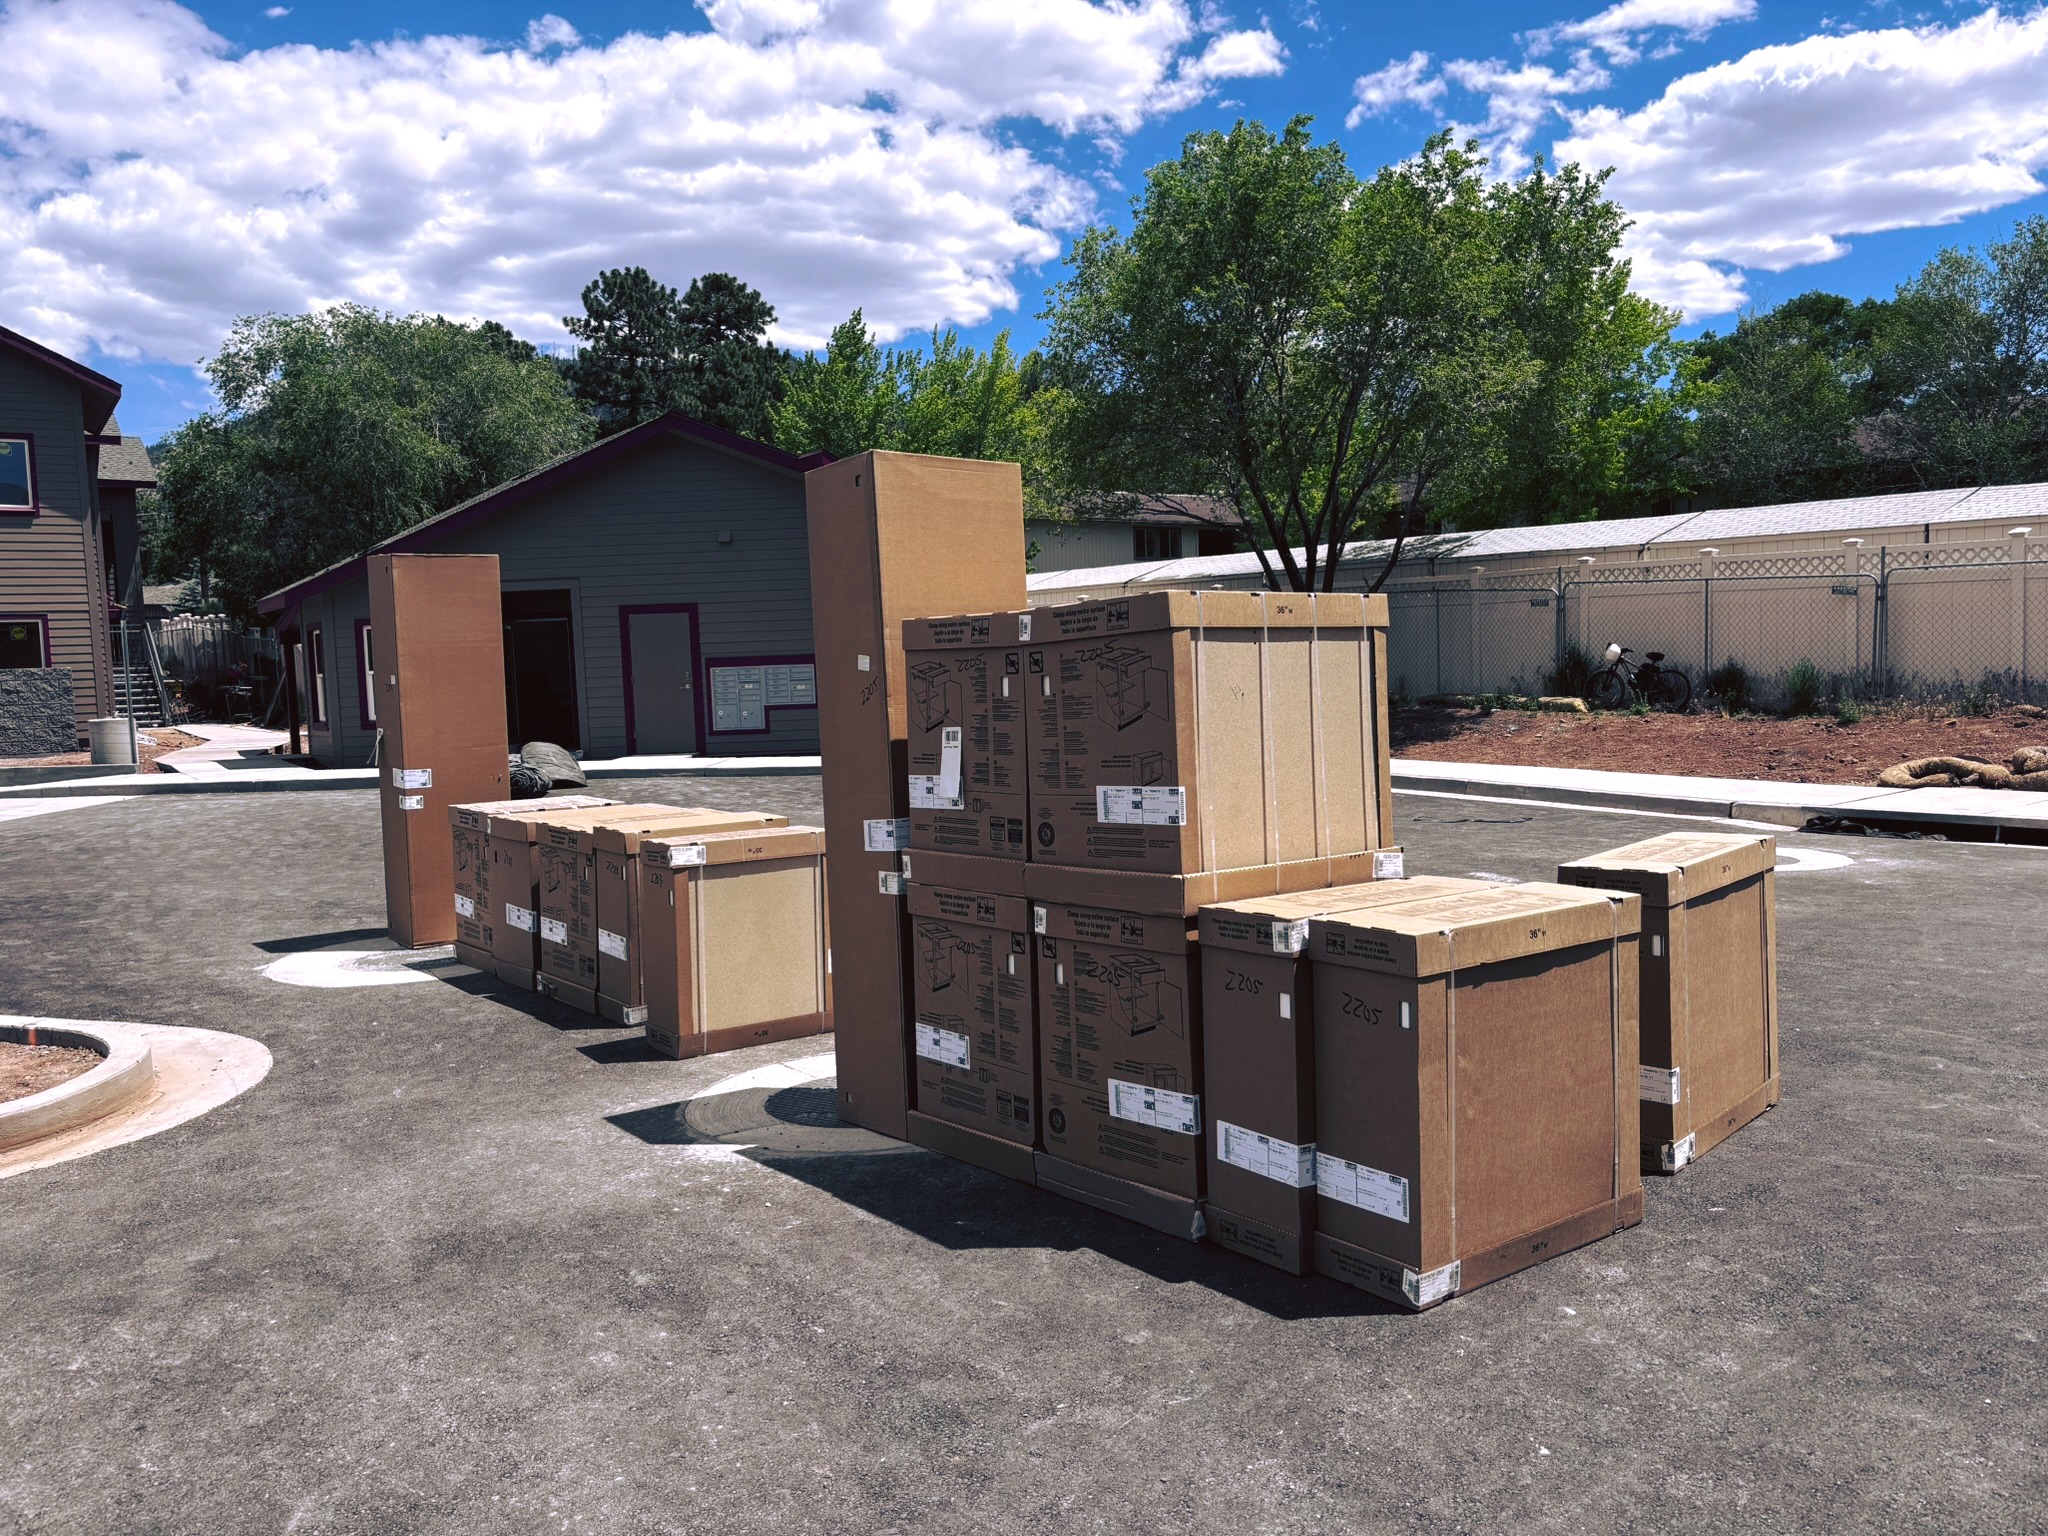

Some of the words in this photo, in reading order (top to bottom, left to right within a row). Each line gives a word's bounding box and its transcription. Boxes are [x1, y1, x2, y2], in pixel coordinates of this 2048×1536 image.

[954, 653, 985, 672] 2205
[1074, 639, 1120, 662] 2205
[860, 675, 879, 706] 2205
[1086, 960, 1126, 987] 2205
[1225, 968, 1264, 994] 2205
[1341, 990, 1383, 1025] 2205
